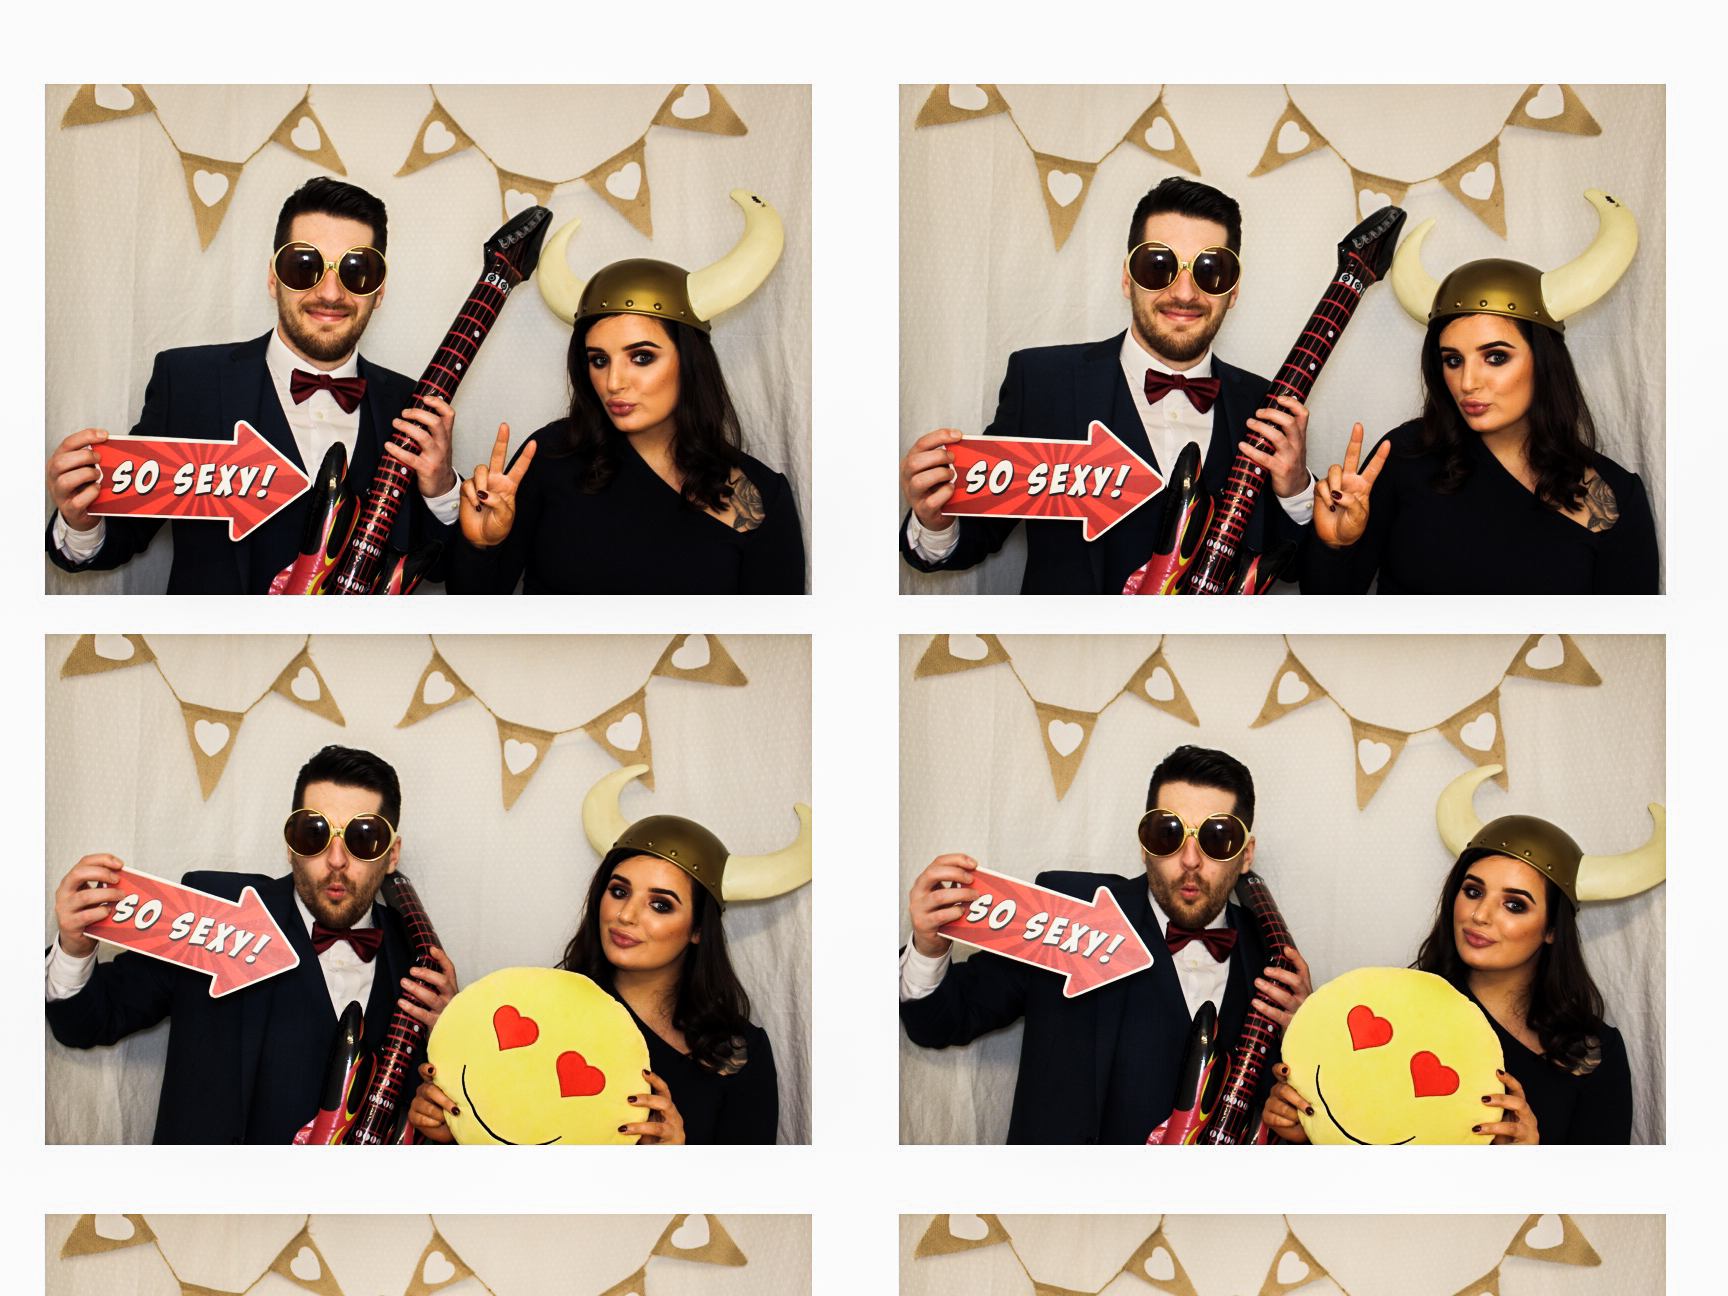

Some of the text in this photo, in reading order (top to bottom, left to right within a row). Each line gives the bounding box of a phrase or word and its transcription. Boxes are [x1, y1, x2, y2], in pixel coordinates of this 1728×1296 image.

[111, 459, 278, 500] SO SEXY!
[965, 459, 1132, 500] SO SEXY!
[111, 893, 272, 965] SO SEXY!
[965, 893, 1126, 965] SO SEXY!
